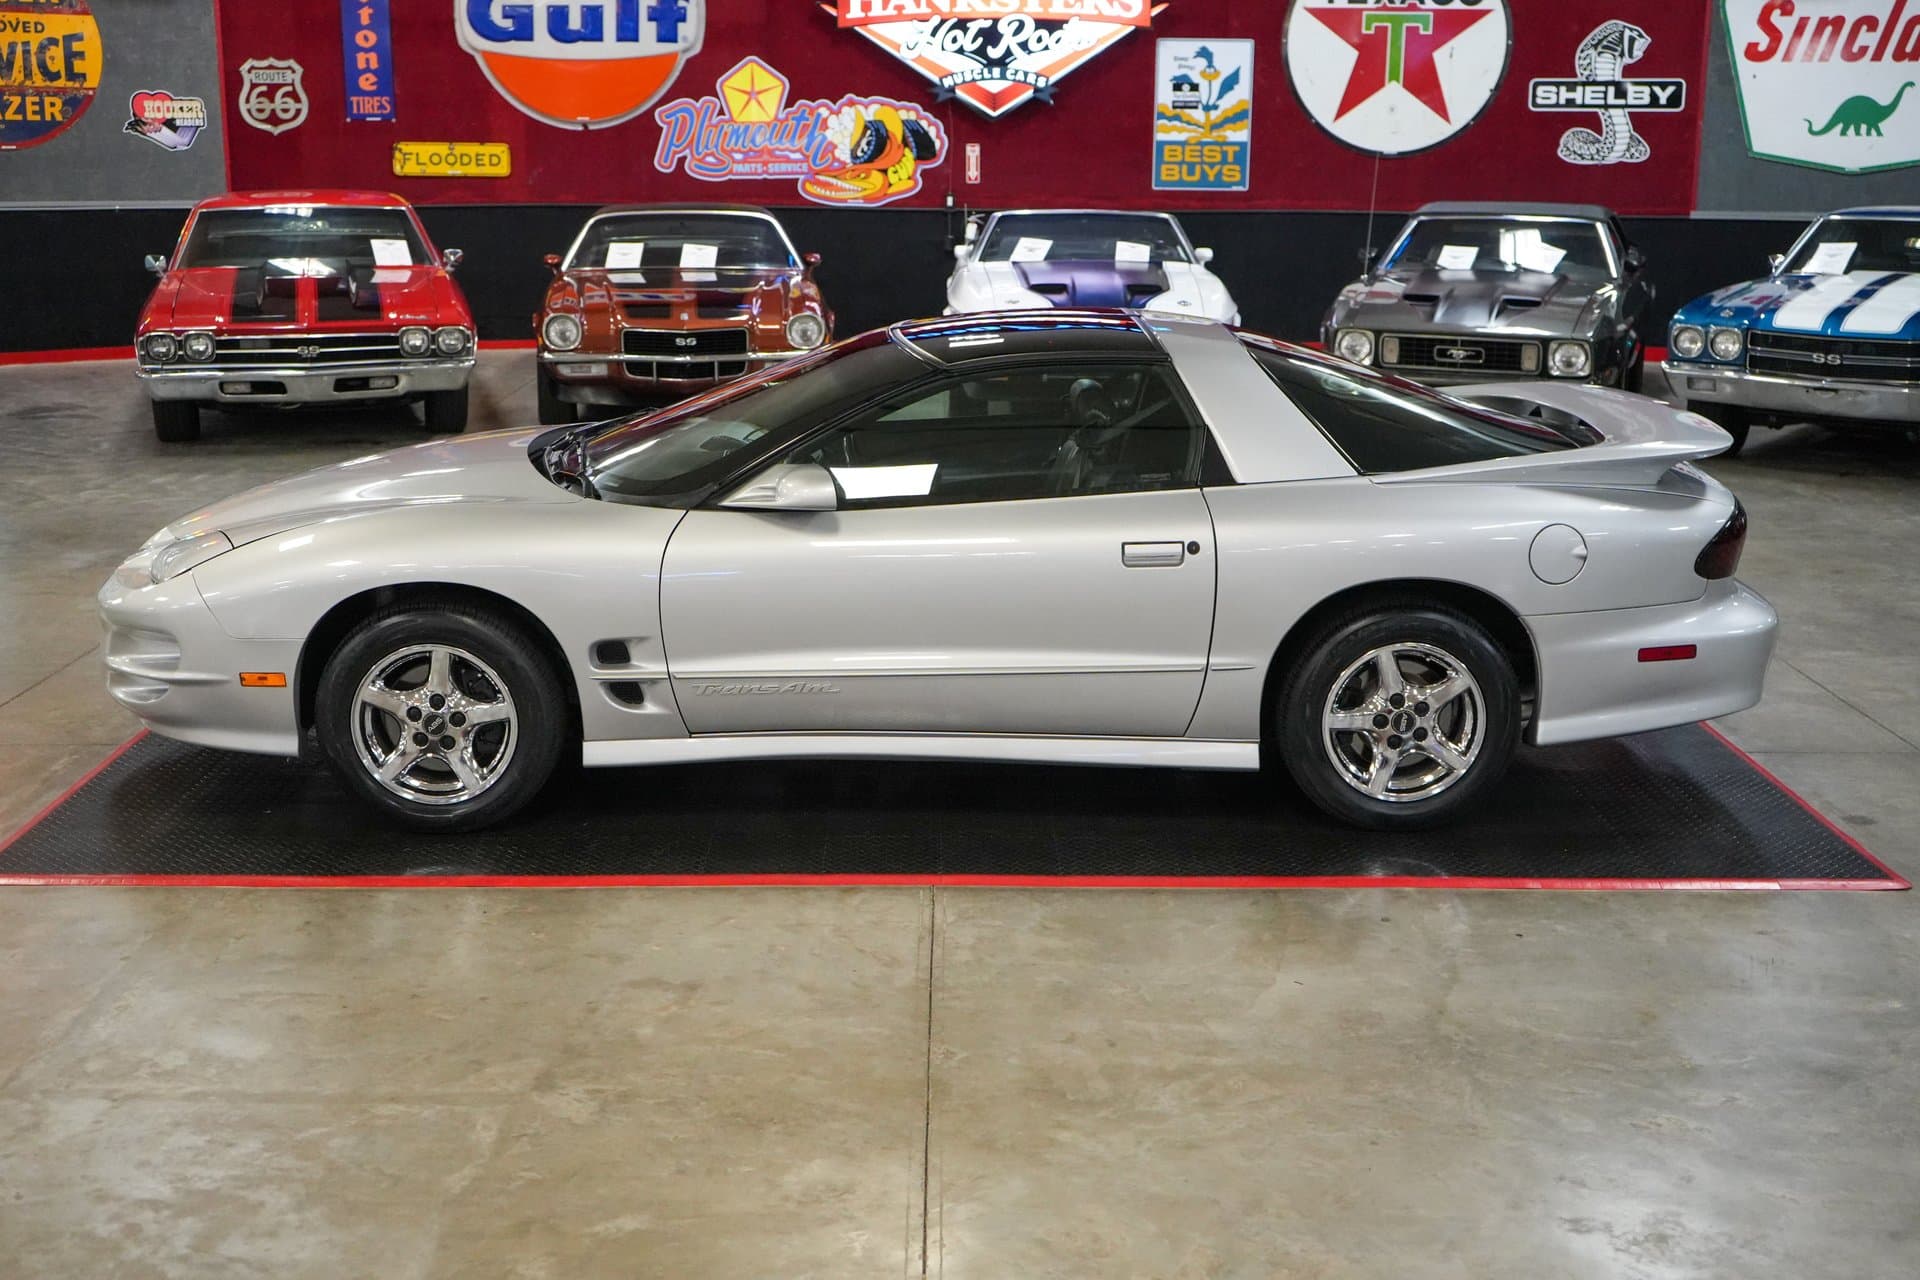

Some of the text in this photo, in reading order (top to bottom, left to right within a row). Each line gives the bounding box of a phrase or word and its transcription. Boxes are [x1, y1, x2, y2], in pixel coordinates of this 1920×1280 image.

[467, 0, 687, 43] Gulf
[355, 0, 378, 91] tone
[900, 15, 993, 59] Hot
[1362, 13, 1433, 85] T
[254, 71, 288, 82] ROUTE
[942, 67, 1048, 88] MUSCLE CARS
[249, 85, 296, 120] 66
[350, 96, 391, 114] TIRES
[1535, 85, 1677, 105] SHELBY
[0, 95, 63, 121] ZER
[143, 99, 204, 119] HOOKER
[663, 104, 831, 173] Plymouth
[402, 152, 502, 167] FLOODED
[1163, 144, 1240, 163] BEST
[1160, 163, 1242, 182] BUYS
[675, 337, 697, 346] SS
[1812, 352, 1841, 365] SS
